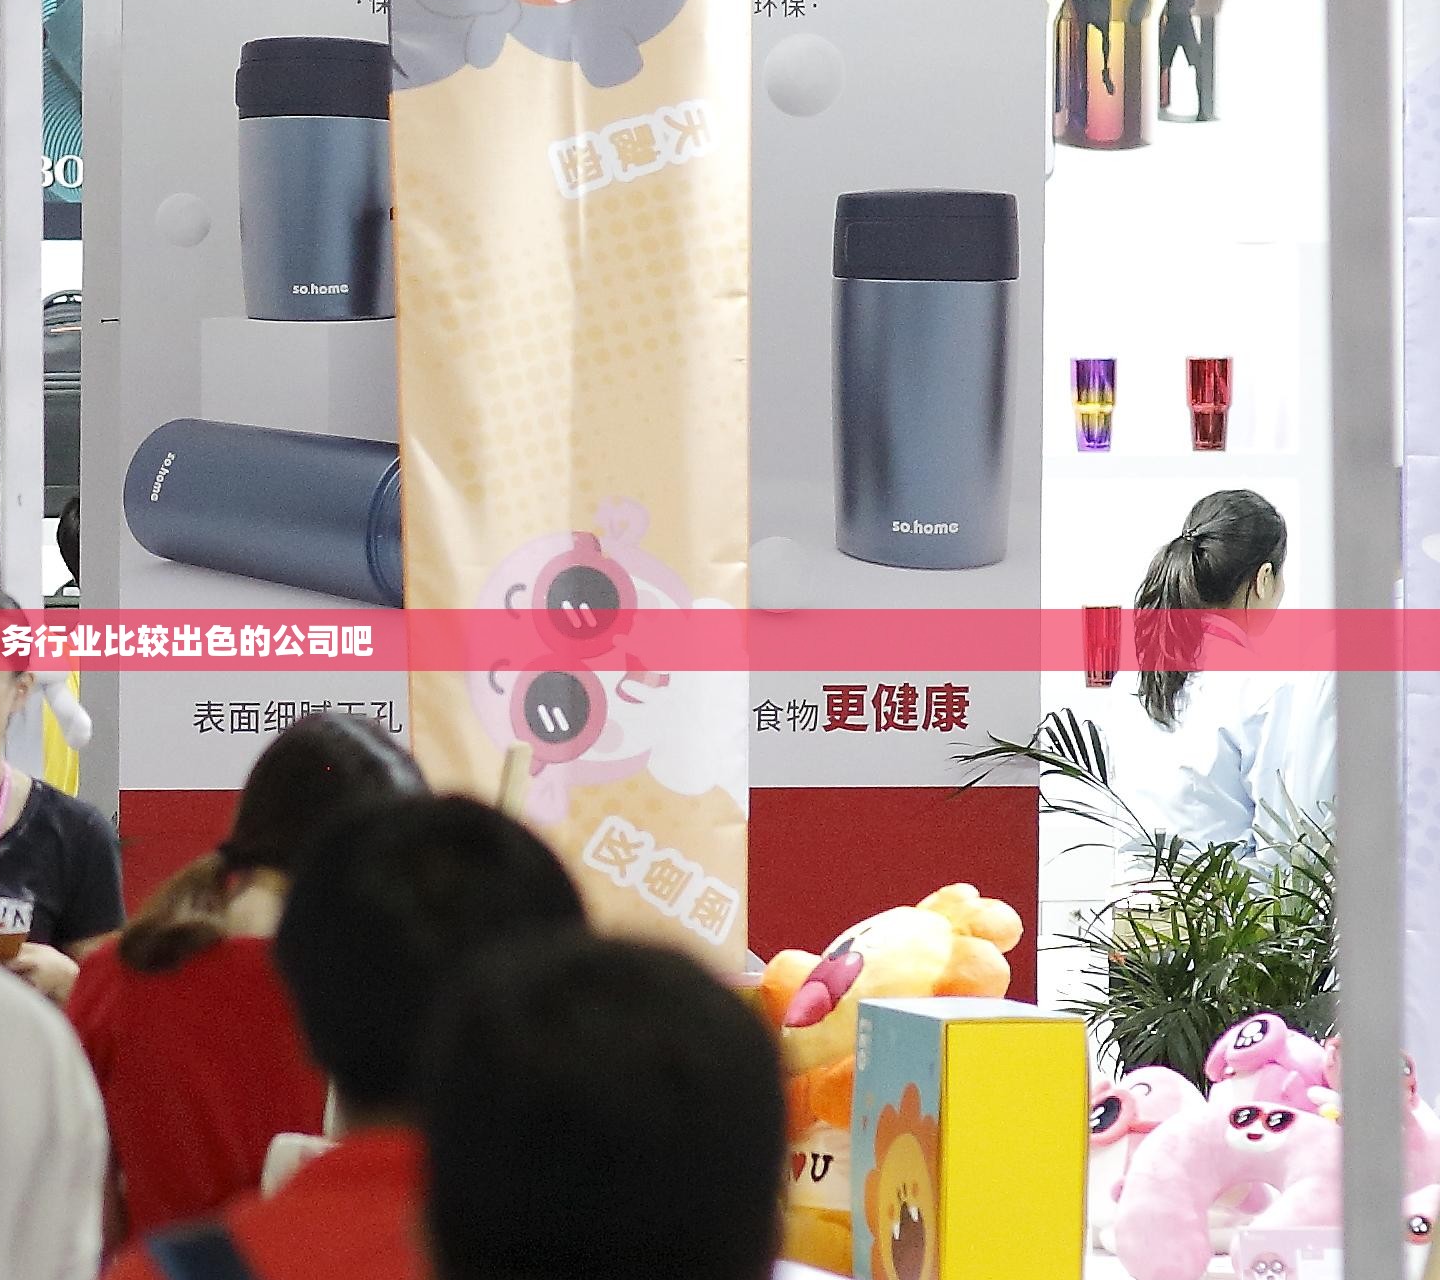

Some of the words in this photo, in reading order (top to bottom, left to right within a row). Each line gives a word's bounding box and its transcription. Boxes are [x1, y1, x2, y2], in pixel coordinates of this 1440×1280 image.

[292, 282, 349, 296] so.home
[150, 451, 175, 503] so.home
[892, 521, 959, 535] so.home
